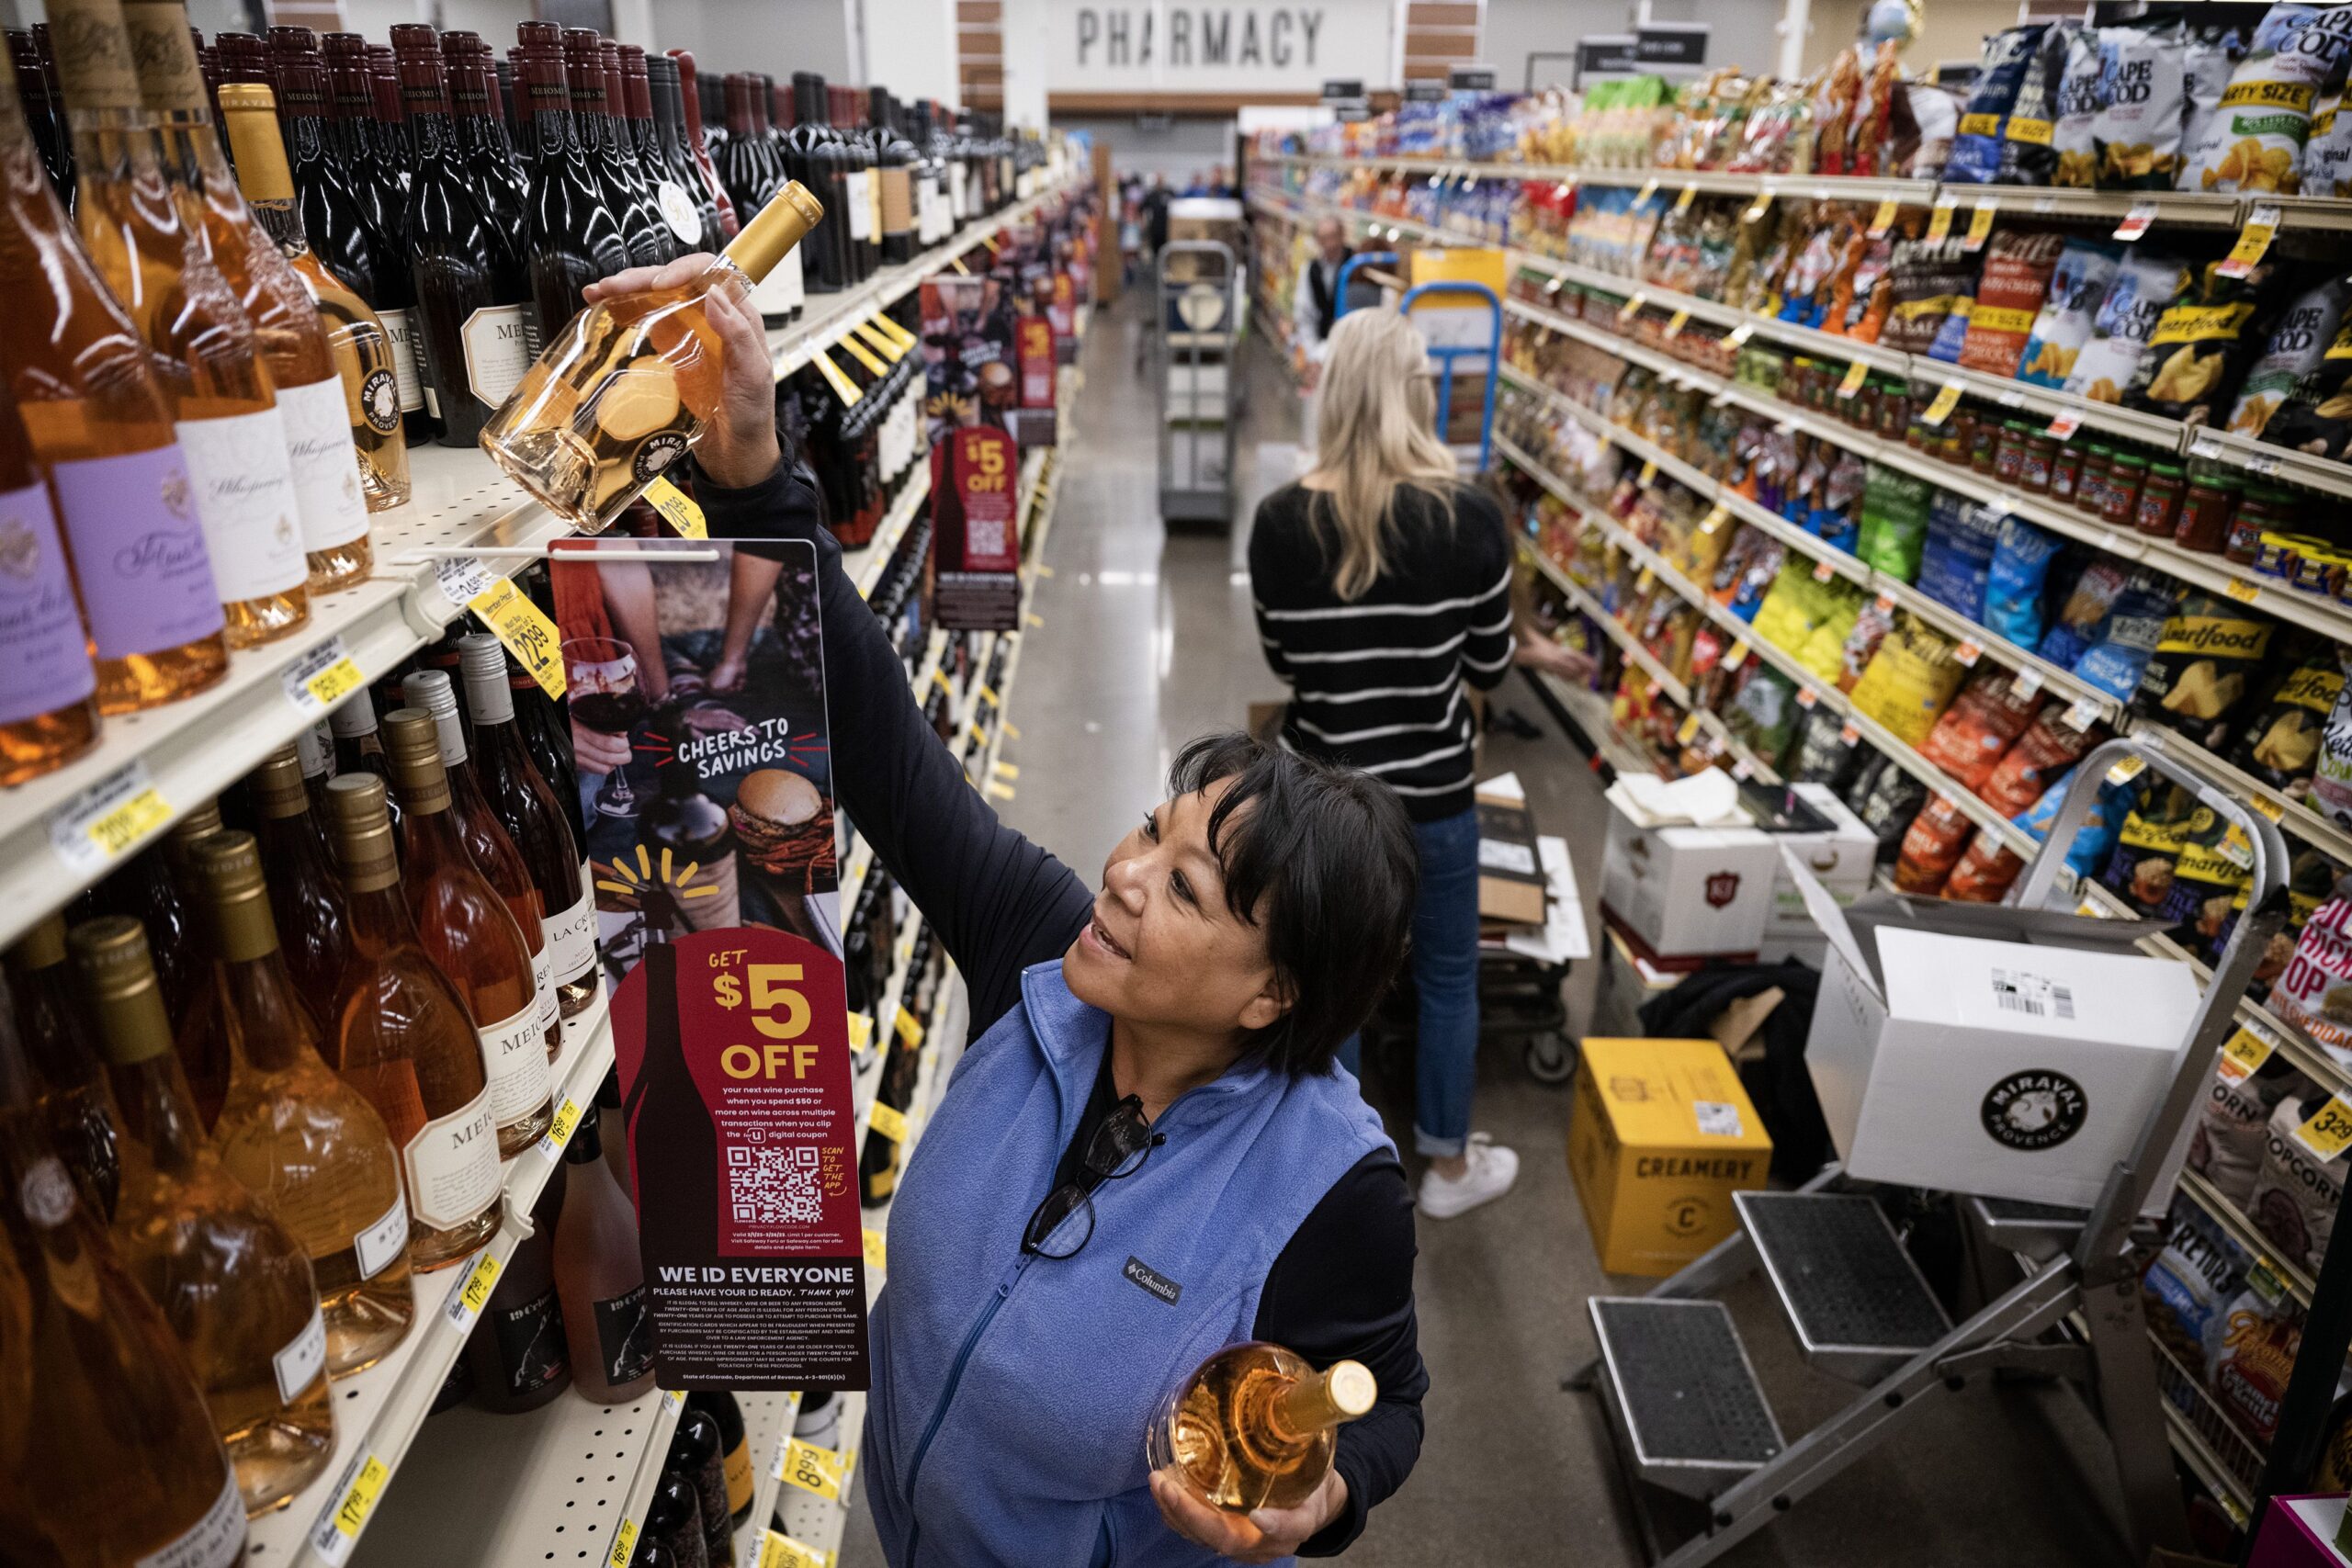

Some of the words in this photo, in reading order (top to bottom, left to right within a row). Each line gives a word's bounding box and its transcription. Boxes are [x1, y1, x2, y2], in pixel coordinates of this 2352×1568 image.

[1078, 9, 1324, 66] PHARMACY
[2278, 29, 2344, 64] COD
[2104, 59, 2153, 83] CAPE
[530, 86, 565, 96] MEIOMI
[2105, 83, 2151, 105] COD
[2261, 84, 2304, 104] SIZE
[364, 373, 397, 402] MIRAVAL
[649, 436, 684, 458] MIRAVA
[678, 725, 756, 763] CHEERS
[759, 717, 789, 741] TO
[698, 739, 786, 780] SAVINGS
[553, 928, 572, 942] LA
[708, 949, 749, 968] GET
[2285, 955, 2326, 1001] OP
[501, 1015, 543, 1055] MEIO
[720, 1044, 820, 1080] OFF
[768, 1098, 795, 1106] spend
[785, 1087, 824, 1095] purchase
[1991, 1076, 2082, 1115] MIRAVAL
[801, 1109, 836, 1117] multiple
[2212, 1084, 2257, 1122] ORN
[451, 1104, 493, 1150] MEIO
[768, 1131, 795, 1139] digital
[816, 1120, 831, 1128] clip
[1990, 1113, 2071, 1146] PROVENCE
[822, 1164, 842, 1172] GET
[1636, 1156, 1753, 1180] CREAMERY
[824, 1181, 841, 1190] APP
[1678, 1205, 1696, 1228] C
[659, 1267, 696, 1282] WE
[702, 1267, 726, 1282] ID
[731, 1268, 854, 1283] EVERYONE
[1136, 1267, 1177, 1300] Columbia
[653, 1288, 687, 1296] PLEASE
[689, 1288, 717, 1296] HAVE
[760, 1289, 796, 1297] READY.
[510, 1308, 525, 1322] 19
[610, 1301, 625, 1312] 19
